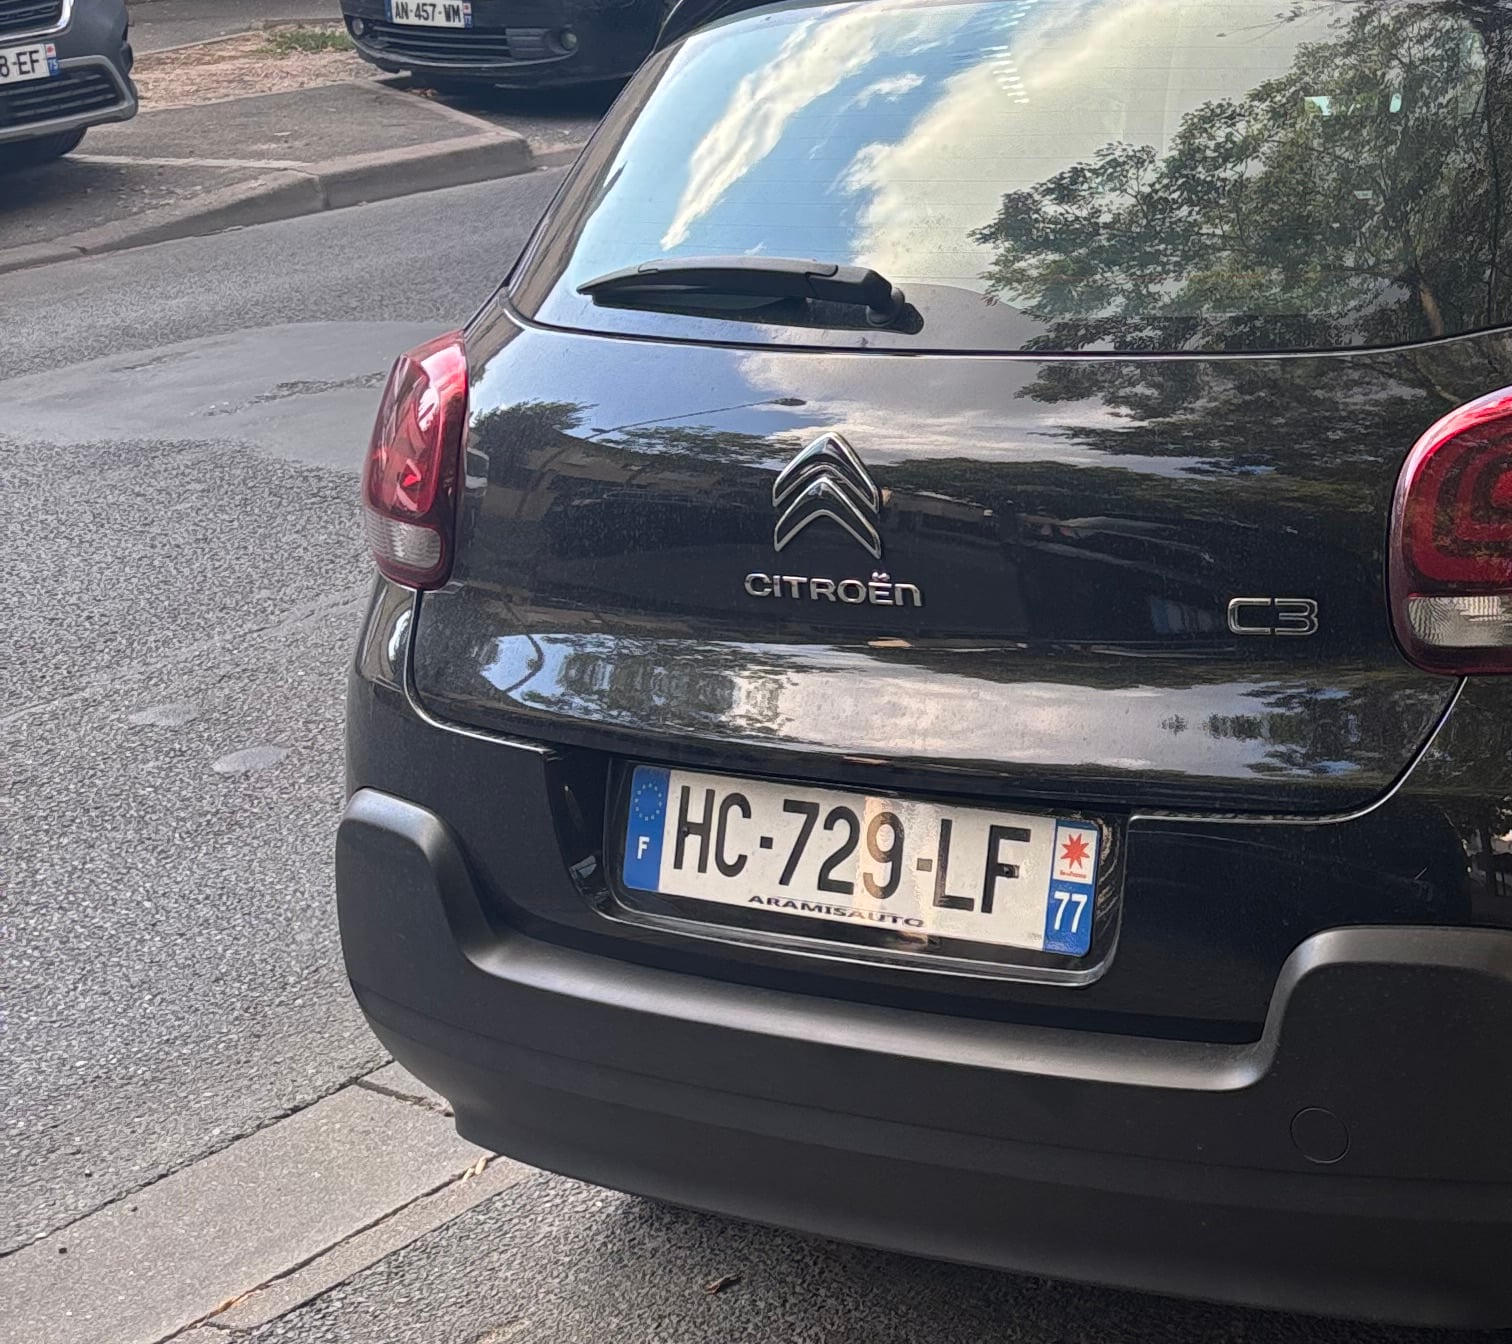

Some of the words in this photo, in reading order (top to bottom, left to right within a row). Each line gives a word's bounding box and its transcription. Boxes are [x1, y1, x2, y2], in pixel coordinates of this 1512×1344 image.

[394, 1, 462, 23] AN-457-WM
[744, 571, 922, 607] CITROËN
[1227, 597, 1319, 636] C3
[636, 835, 650, 860] F
[673, 785, 1032, 914] HC-729-LF
[1053, 890, 1088, 934] 77
[748, 895, 925, 928] ARAMISAUTO
